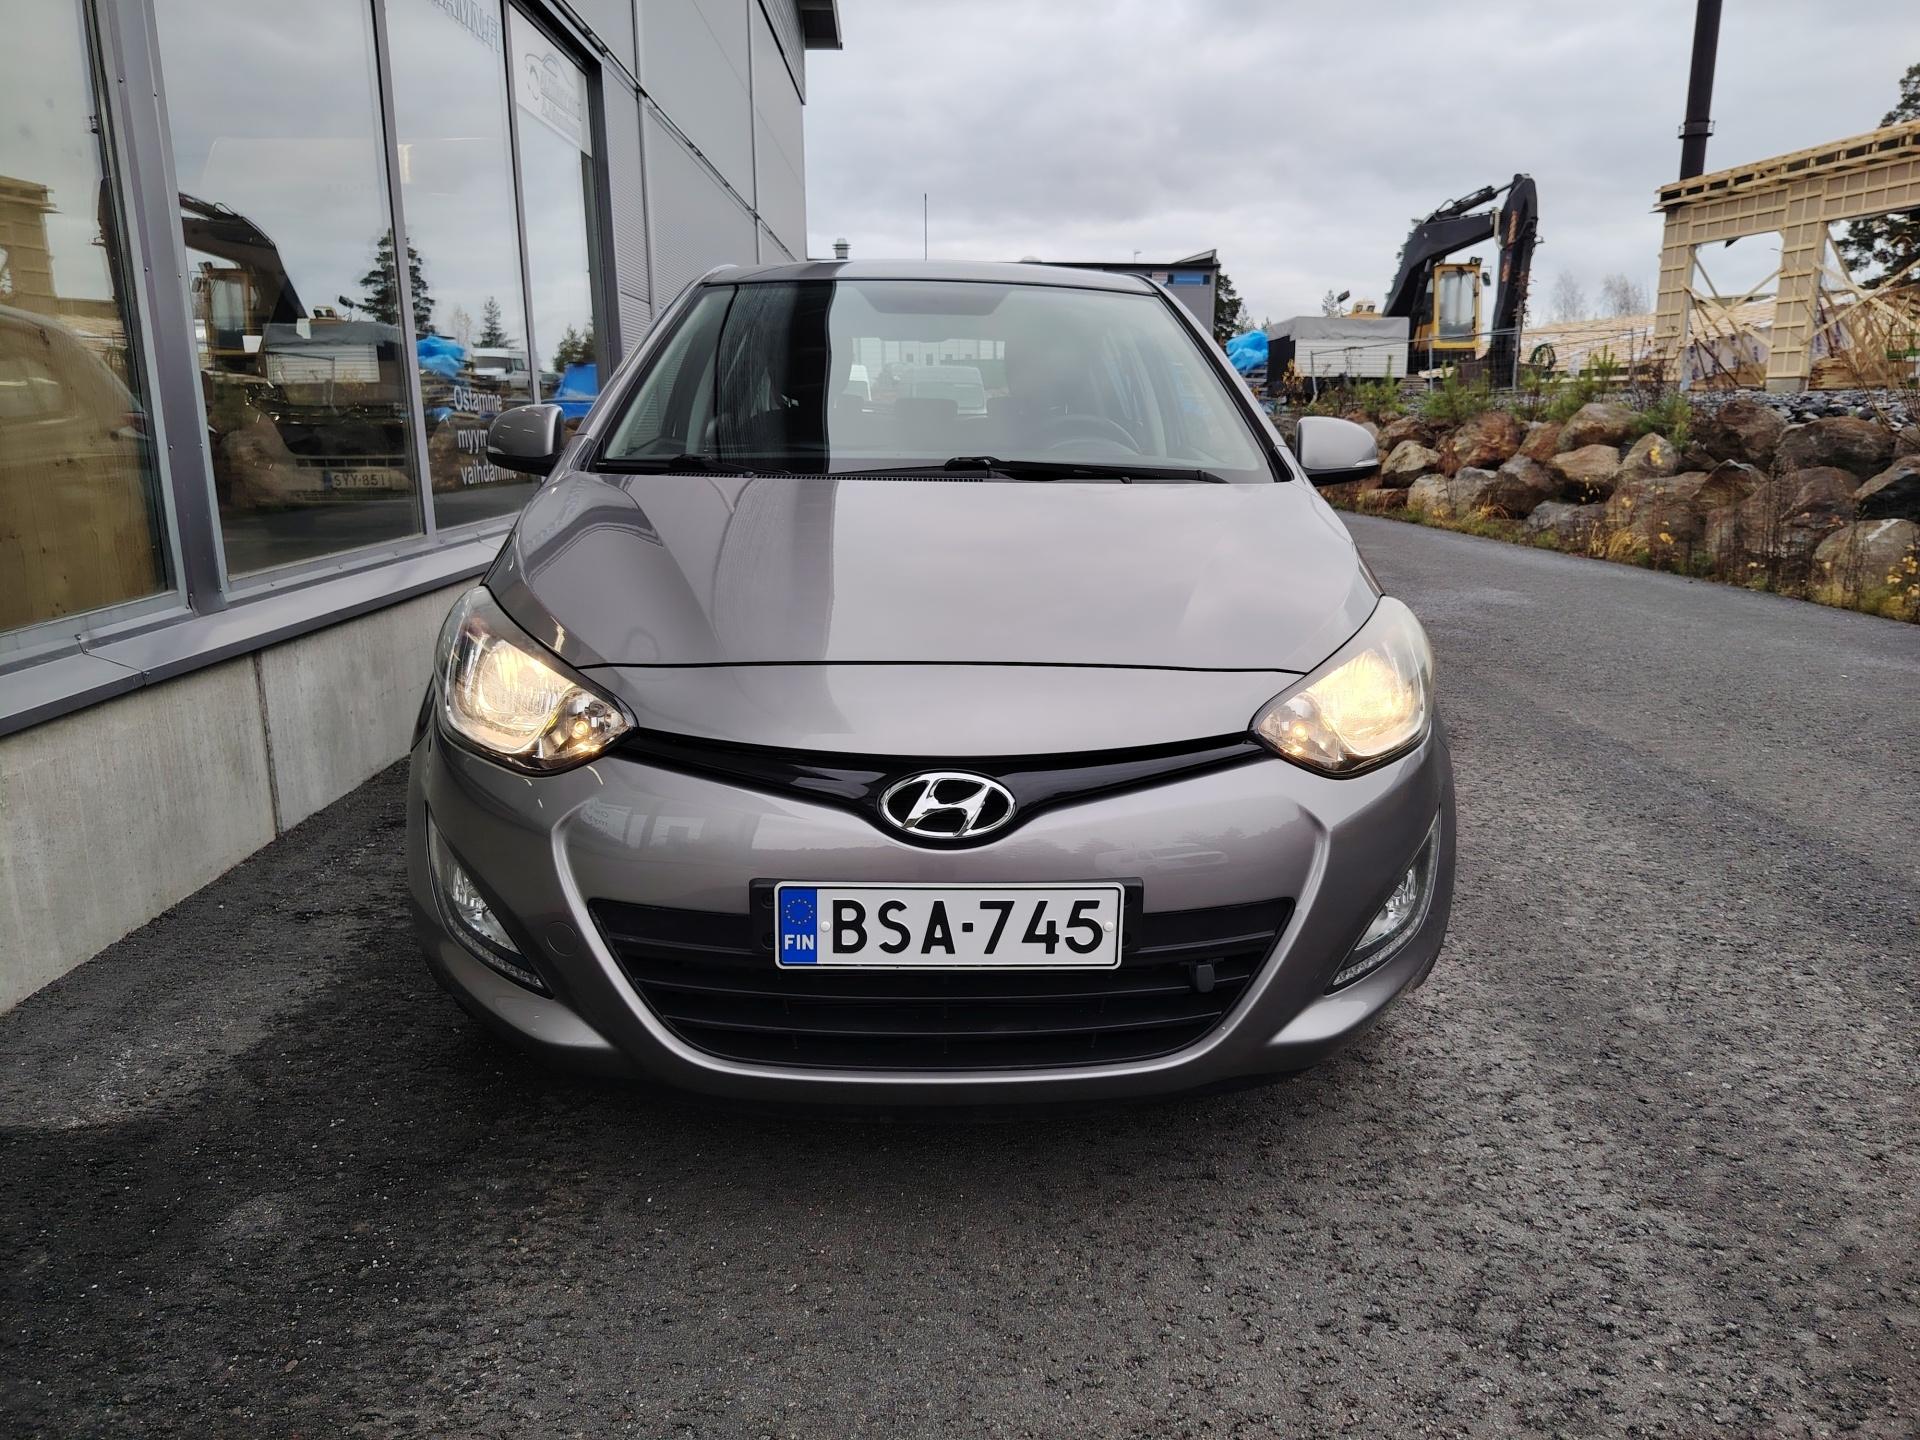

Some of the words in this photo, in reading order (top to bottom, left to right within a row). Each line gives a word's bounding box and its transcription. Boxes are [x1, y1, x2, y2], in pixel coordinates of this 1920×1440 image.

[454, 386, 502, 411] Ostamme
[833, 900, 1103, 954] BSA-745
[784, 934, 814, 950] FIN
